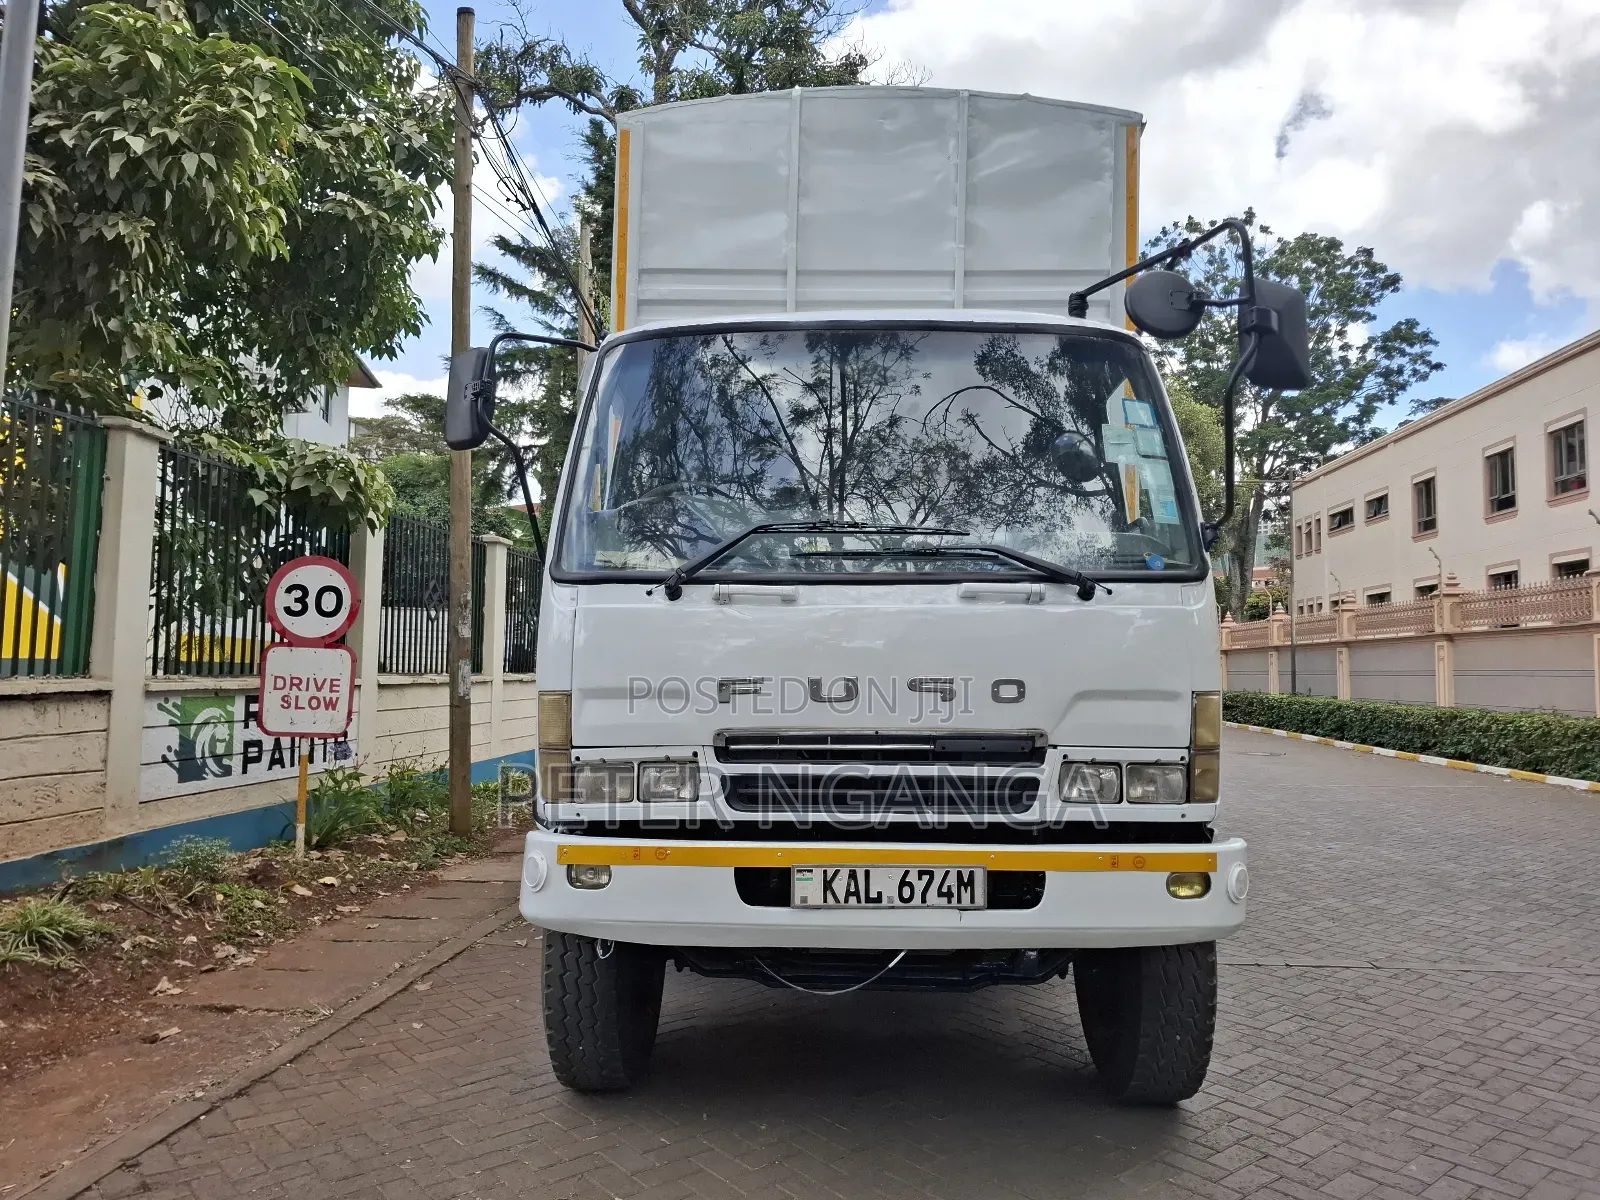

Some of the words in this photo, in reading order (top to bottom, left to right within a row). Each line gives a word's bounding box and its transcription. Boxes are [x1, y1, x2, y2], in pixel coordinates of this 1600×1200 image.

[282, 583, 344, 618] 30
[273, 675, 341, 694] DRIVE
[716, 676, 1026, 704] FUSO
[280, 694, 340, 711] SLOW
[822, 869, 883, 904] KAL
[897, 869, 975, 904] 674M
